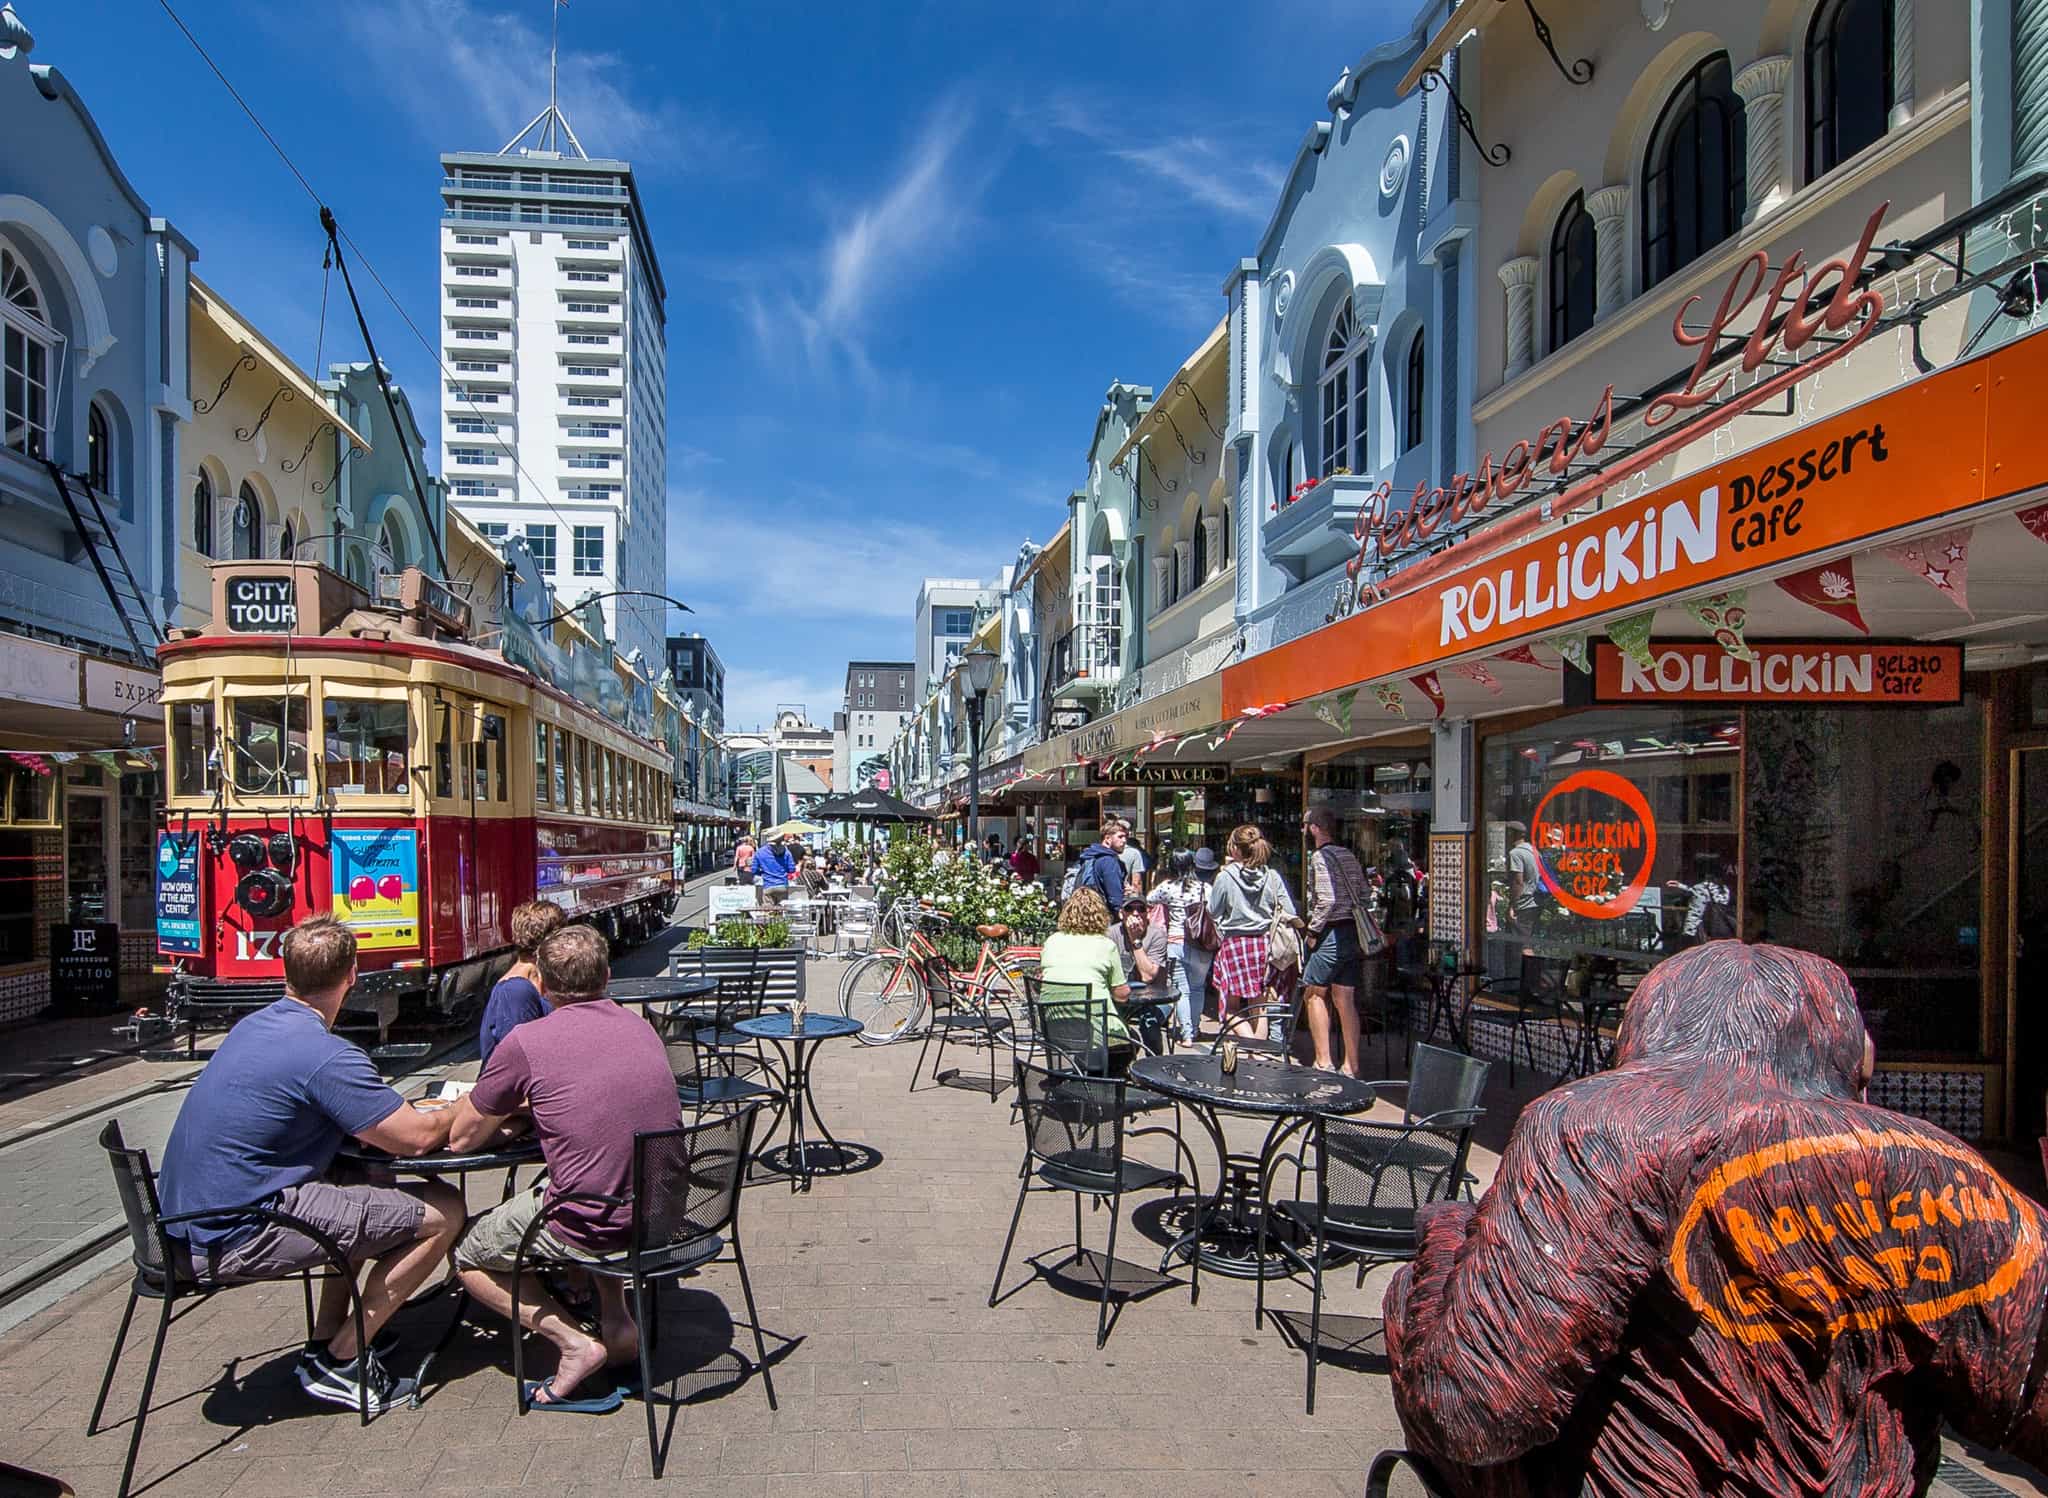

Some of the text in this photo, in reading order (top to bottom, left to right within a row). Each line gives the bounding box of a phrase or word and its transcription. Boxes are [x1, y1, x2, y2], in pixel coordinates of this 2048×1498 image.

[1346, 201, 1891, 579] Petersens Ltd
[1728, 423, 1889, 514] Dessert
[1731, 497, 1806, 553] cafe
[237, 582, 290, 601] CITY
[231, 604, 297, 624] TOUR
[1882, 675, 1924, 695] cafe
[1557, 851, 1623, 874] dessert
[160, 882, 193, 893] NOW OPEN
[1572, 874, 1610, 896] cafe
[165, 904, 190, 915] CENTRE
[58, 968, 112, 978] TATTOO
